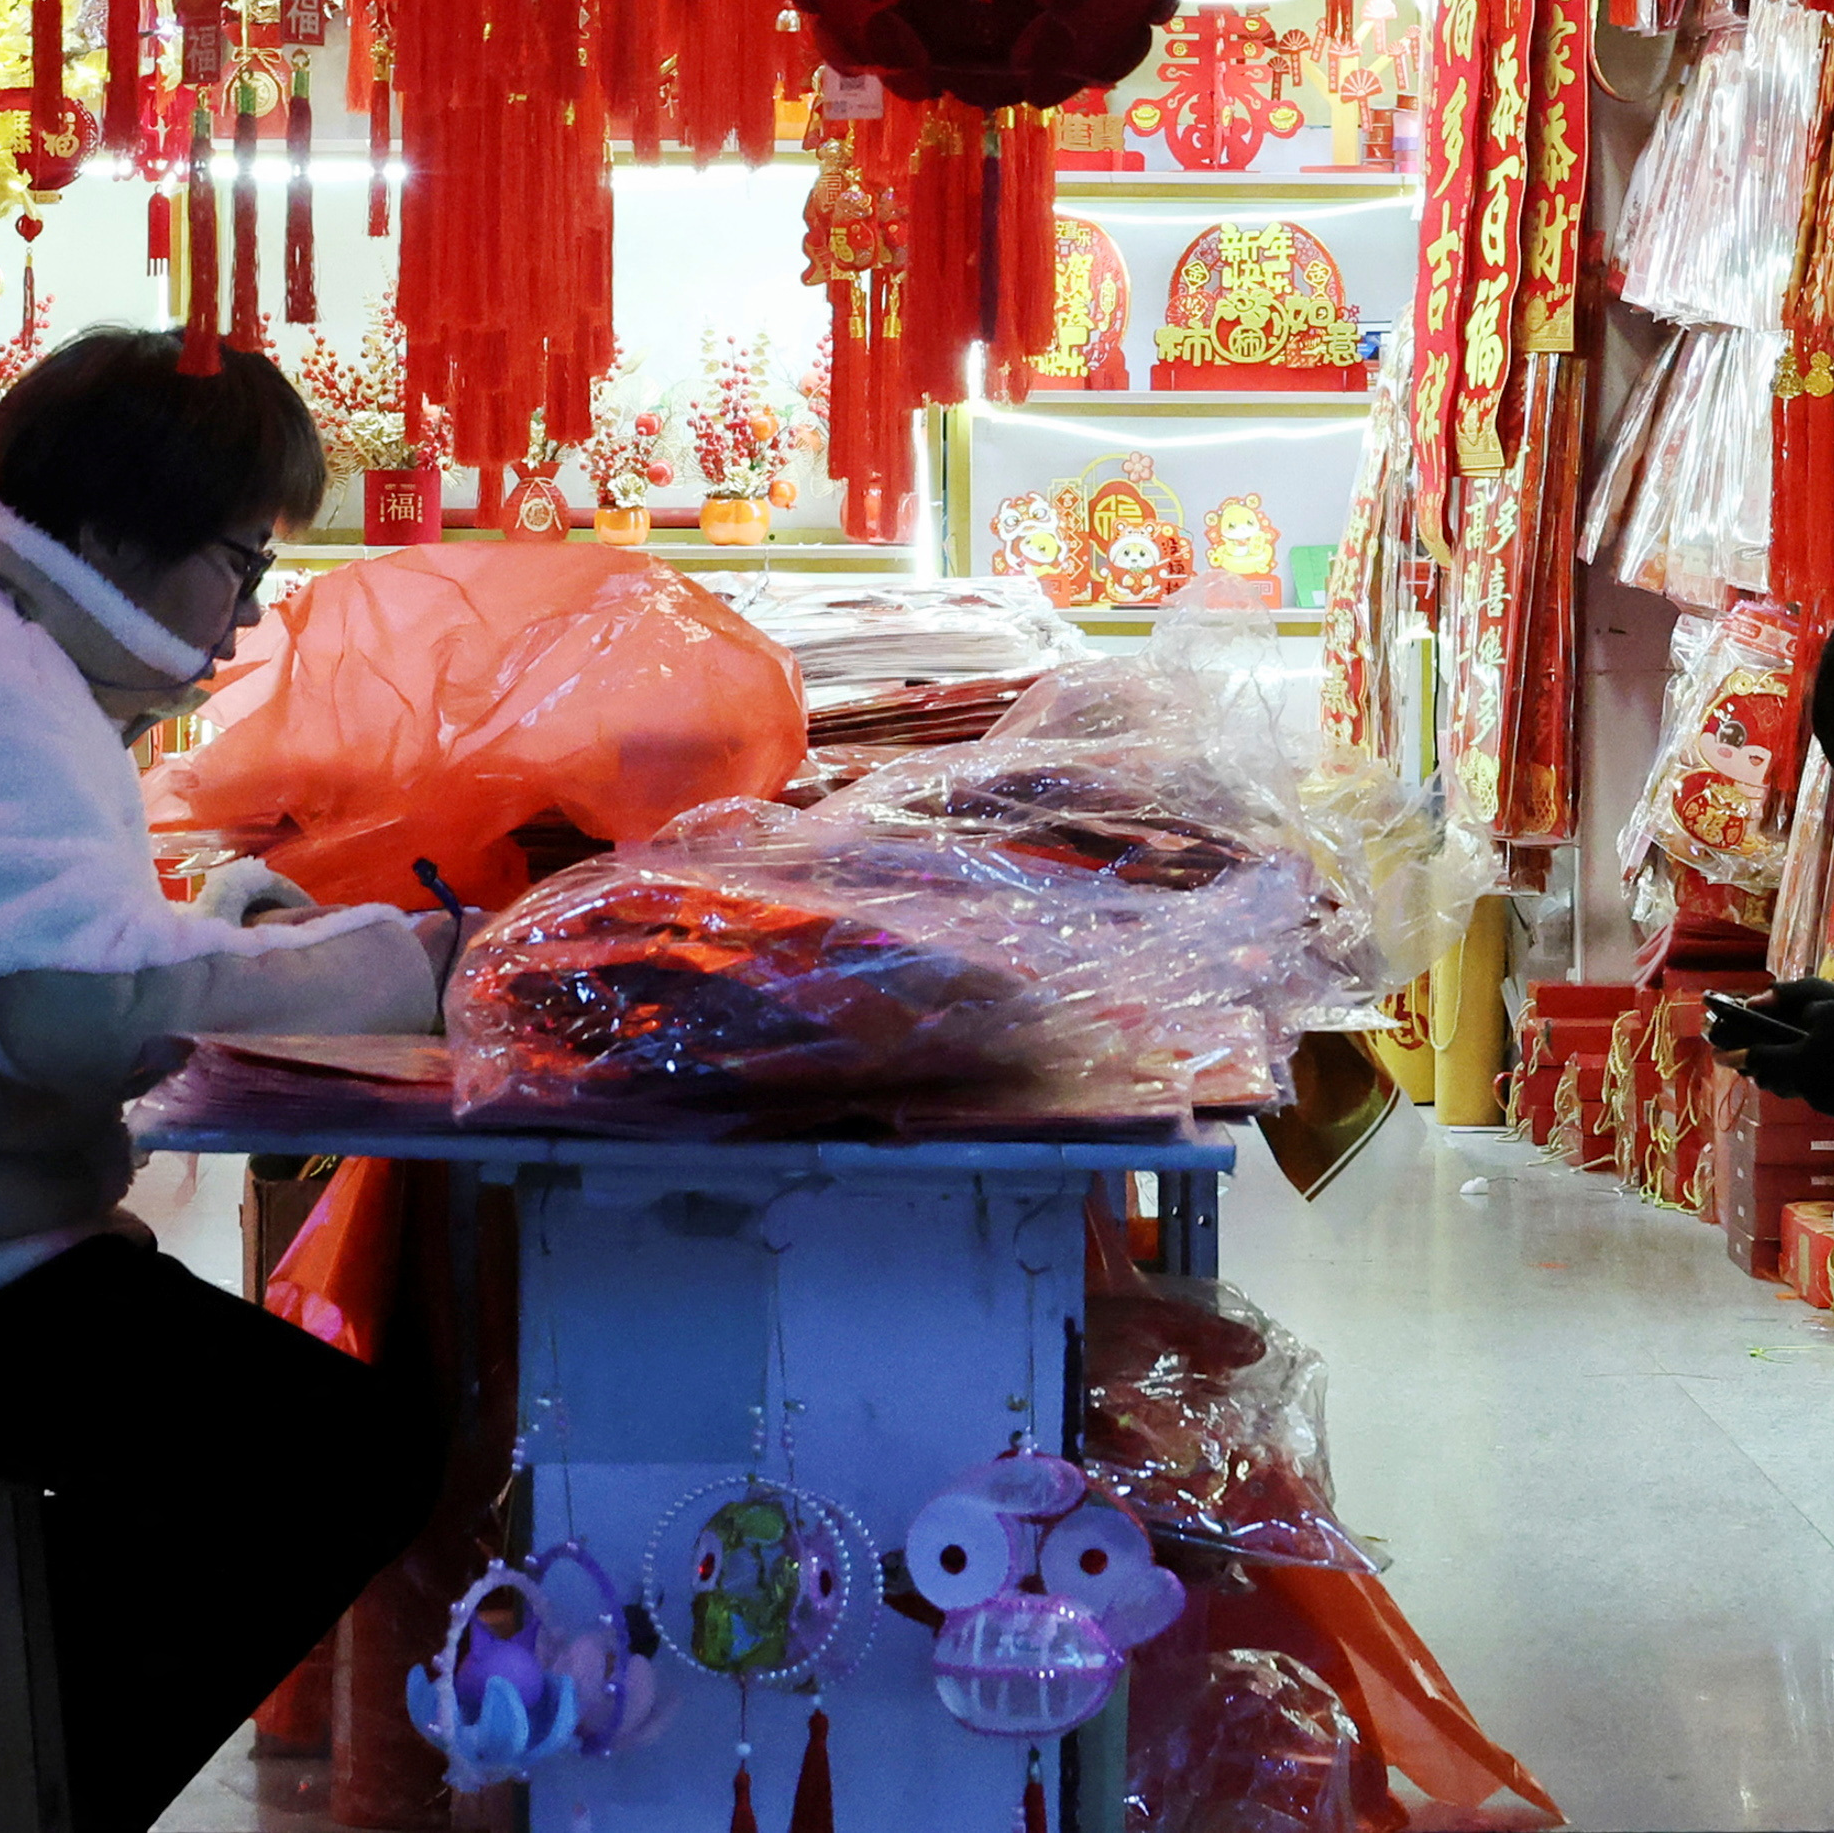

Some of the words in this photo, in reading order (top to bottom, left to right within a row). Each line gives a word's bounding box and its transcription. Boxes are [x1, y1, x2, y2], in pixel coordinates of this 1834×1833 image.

[186, 25, 217, 74] 福
[41, 112, 81, 158] 福
[1220, 222, 1297, 261] 新年
[1222, 261, 1294, 295] 快乐
[386, 490, 414, 521] 福
[1093, 493, 1144, 545] 福
